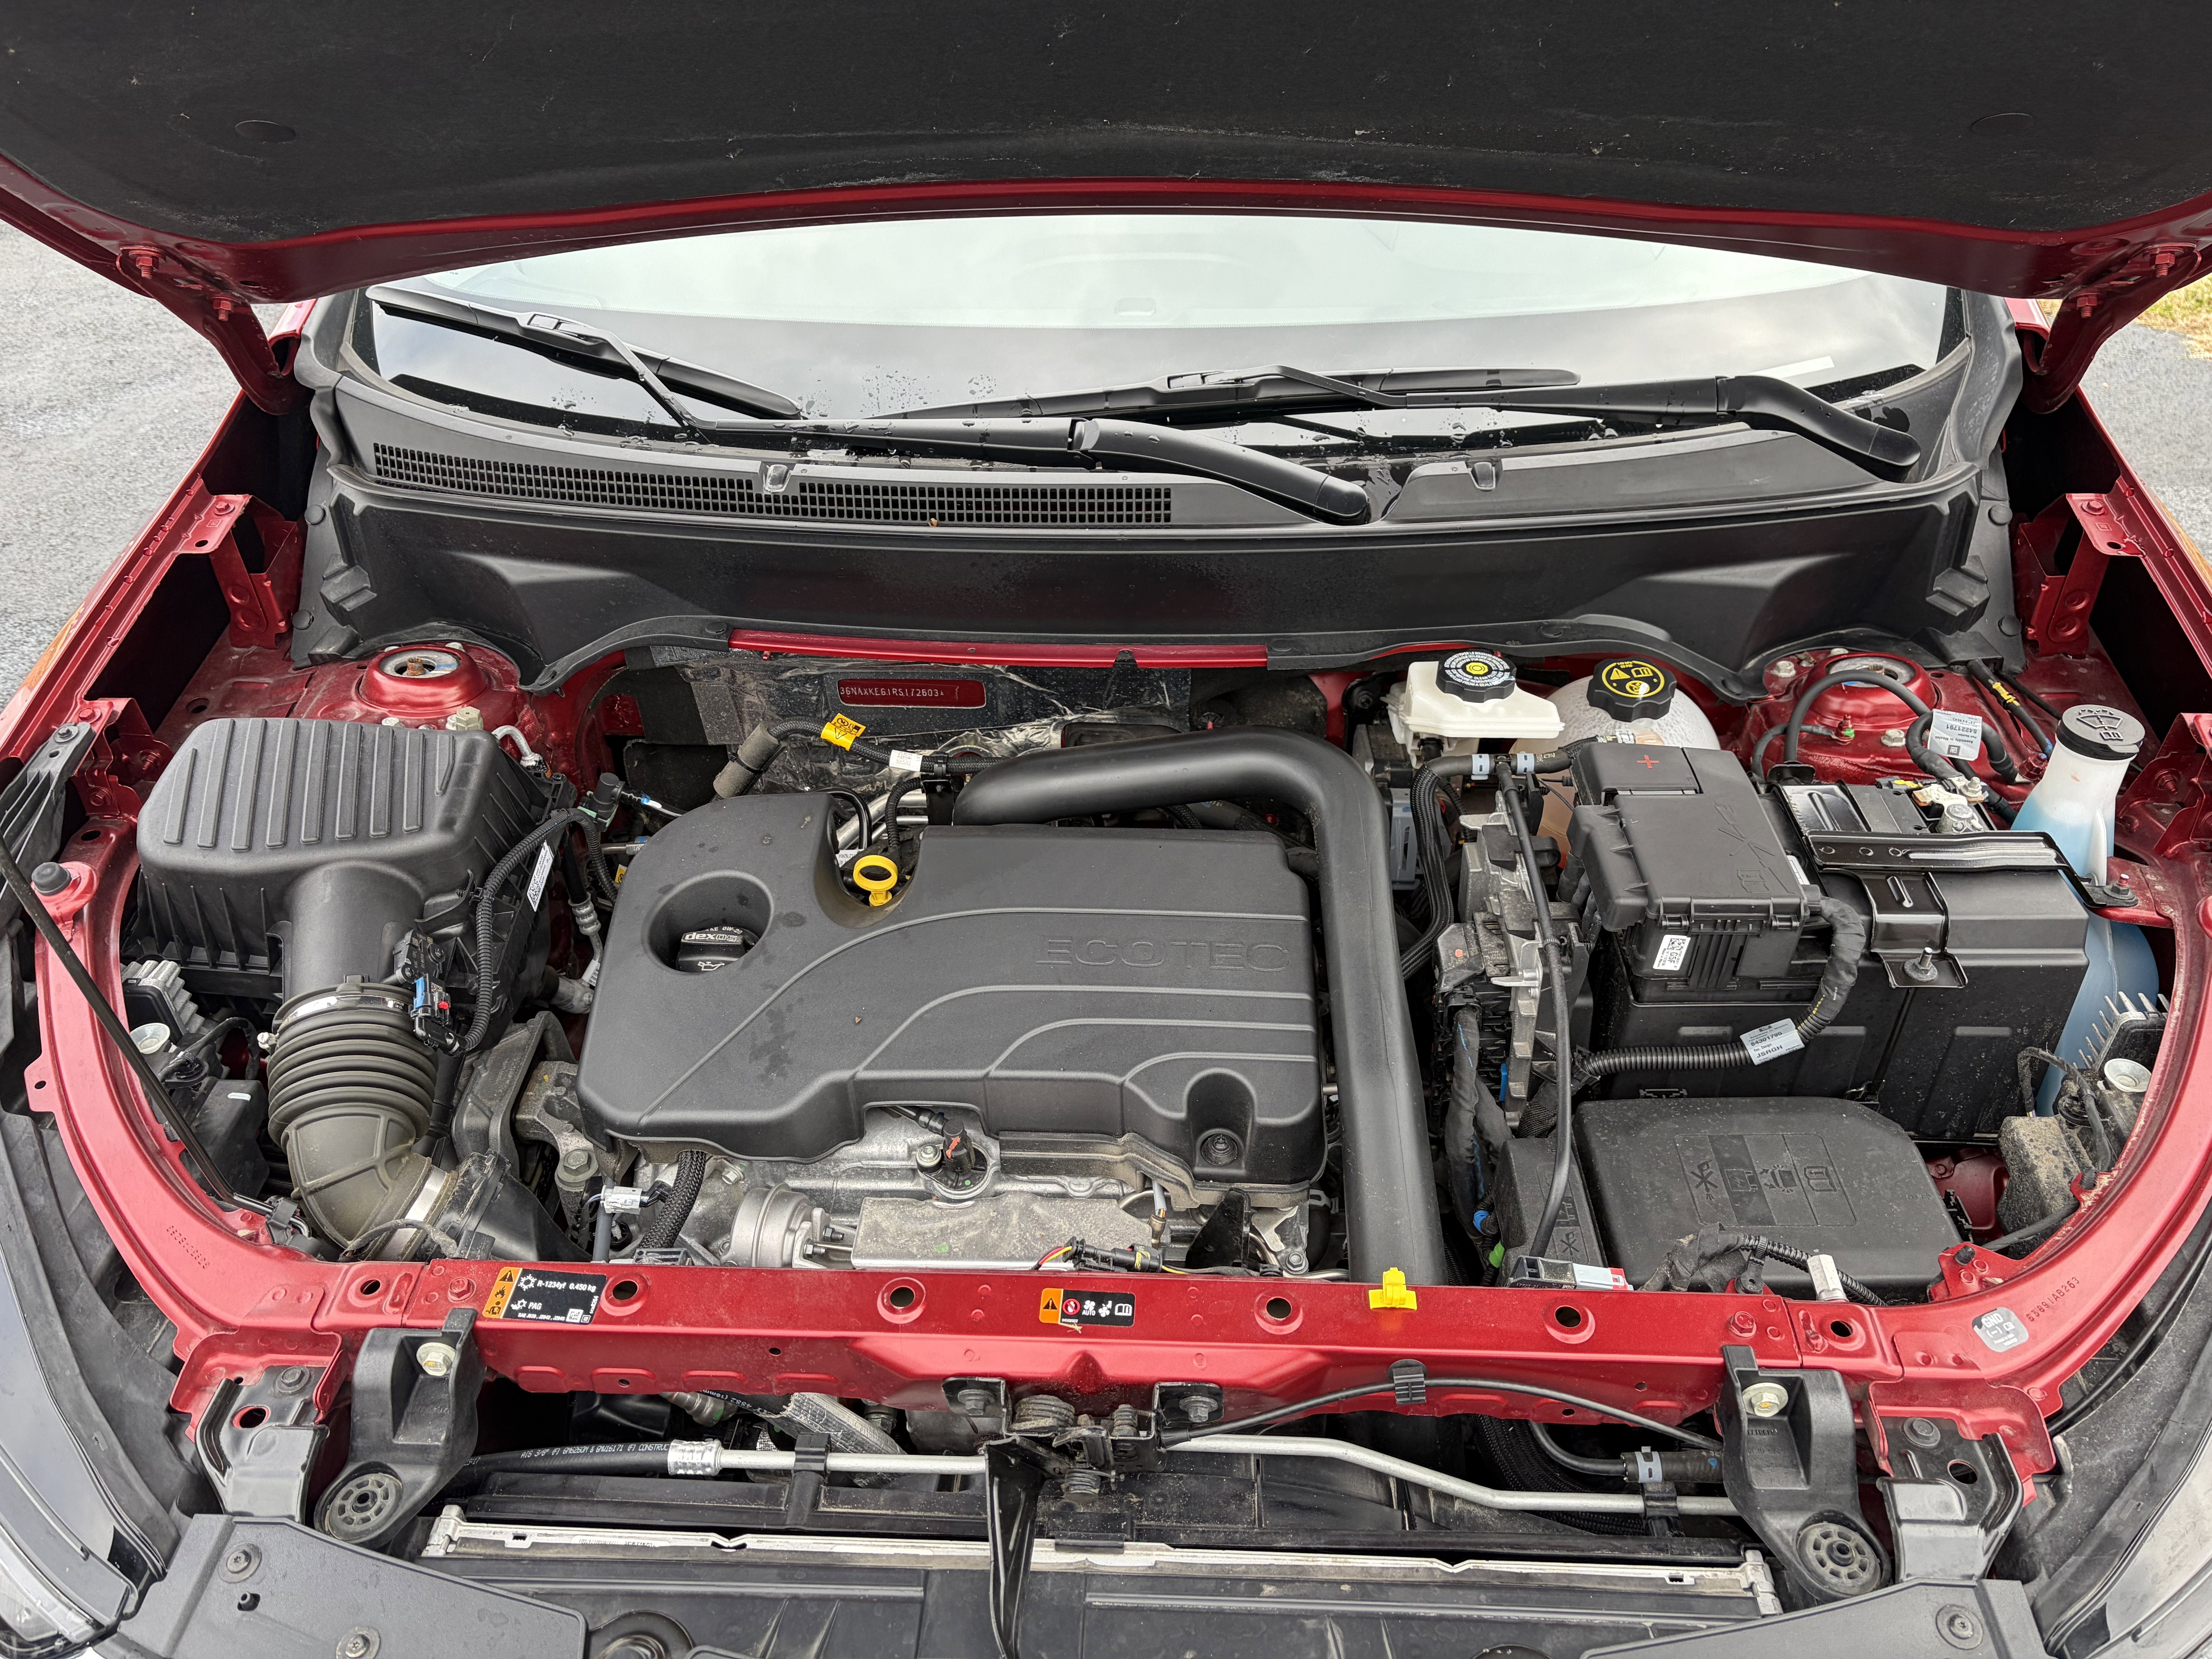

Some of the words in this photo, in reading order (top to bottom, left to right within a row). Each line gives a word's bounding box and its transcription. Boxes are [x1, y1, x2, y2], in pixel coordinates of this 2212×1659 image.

[1946, 724, 1977, 734] 84221791
[685, 932, 738, 941] dexos
[1036, 939, 1290, 972] ECOTEC
[1668, 952, 1678, 964] G5F
[569, 1283, 587, 1291] 0.450
[587, 1285, 597, 1293] kg
[528, 1302, 542, 1310] PAG
[1981, 1313, 2004, 1328] GND
[730, 1397, 752, 1408] 4882
